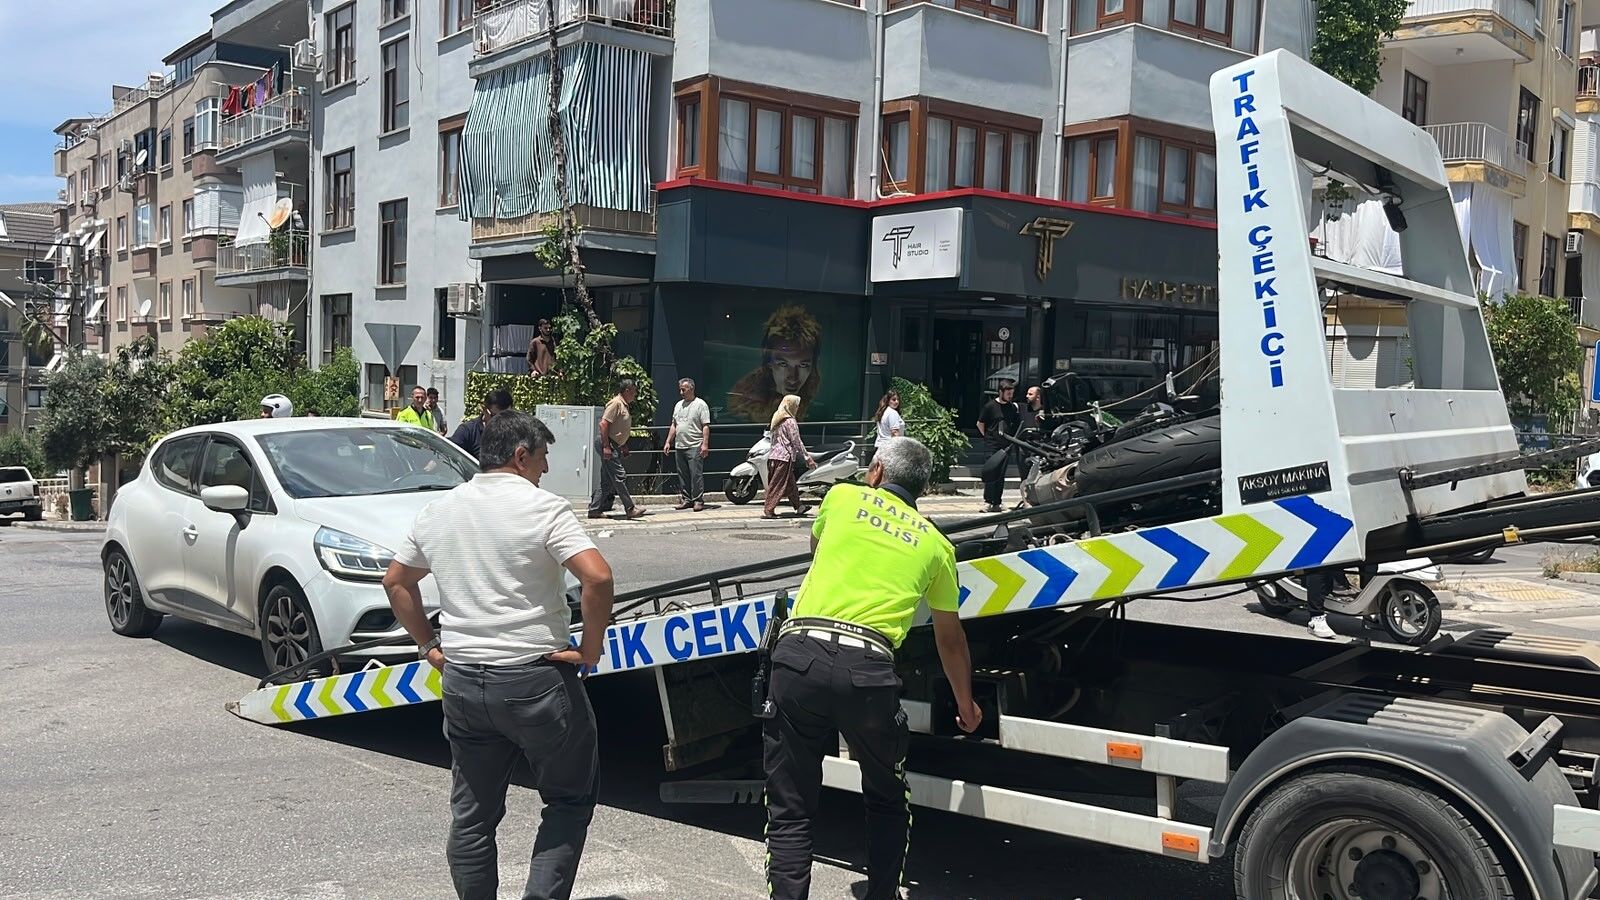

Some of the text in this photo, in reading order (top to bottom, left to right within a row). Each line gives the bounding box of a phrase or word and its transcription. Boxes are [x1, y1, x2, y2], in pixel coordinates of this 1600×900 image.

[1242, 474, 1280, 491] AKSOY
[1282, 467, 1327, 484] MAKINA
[834, 622, 863, 634] POLIS
